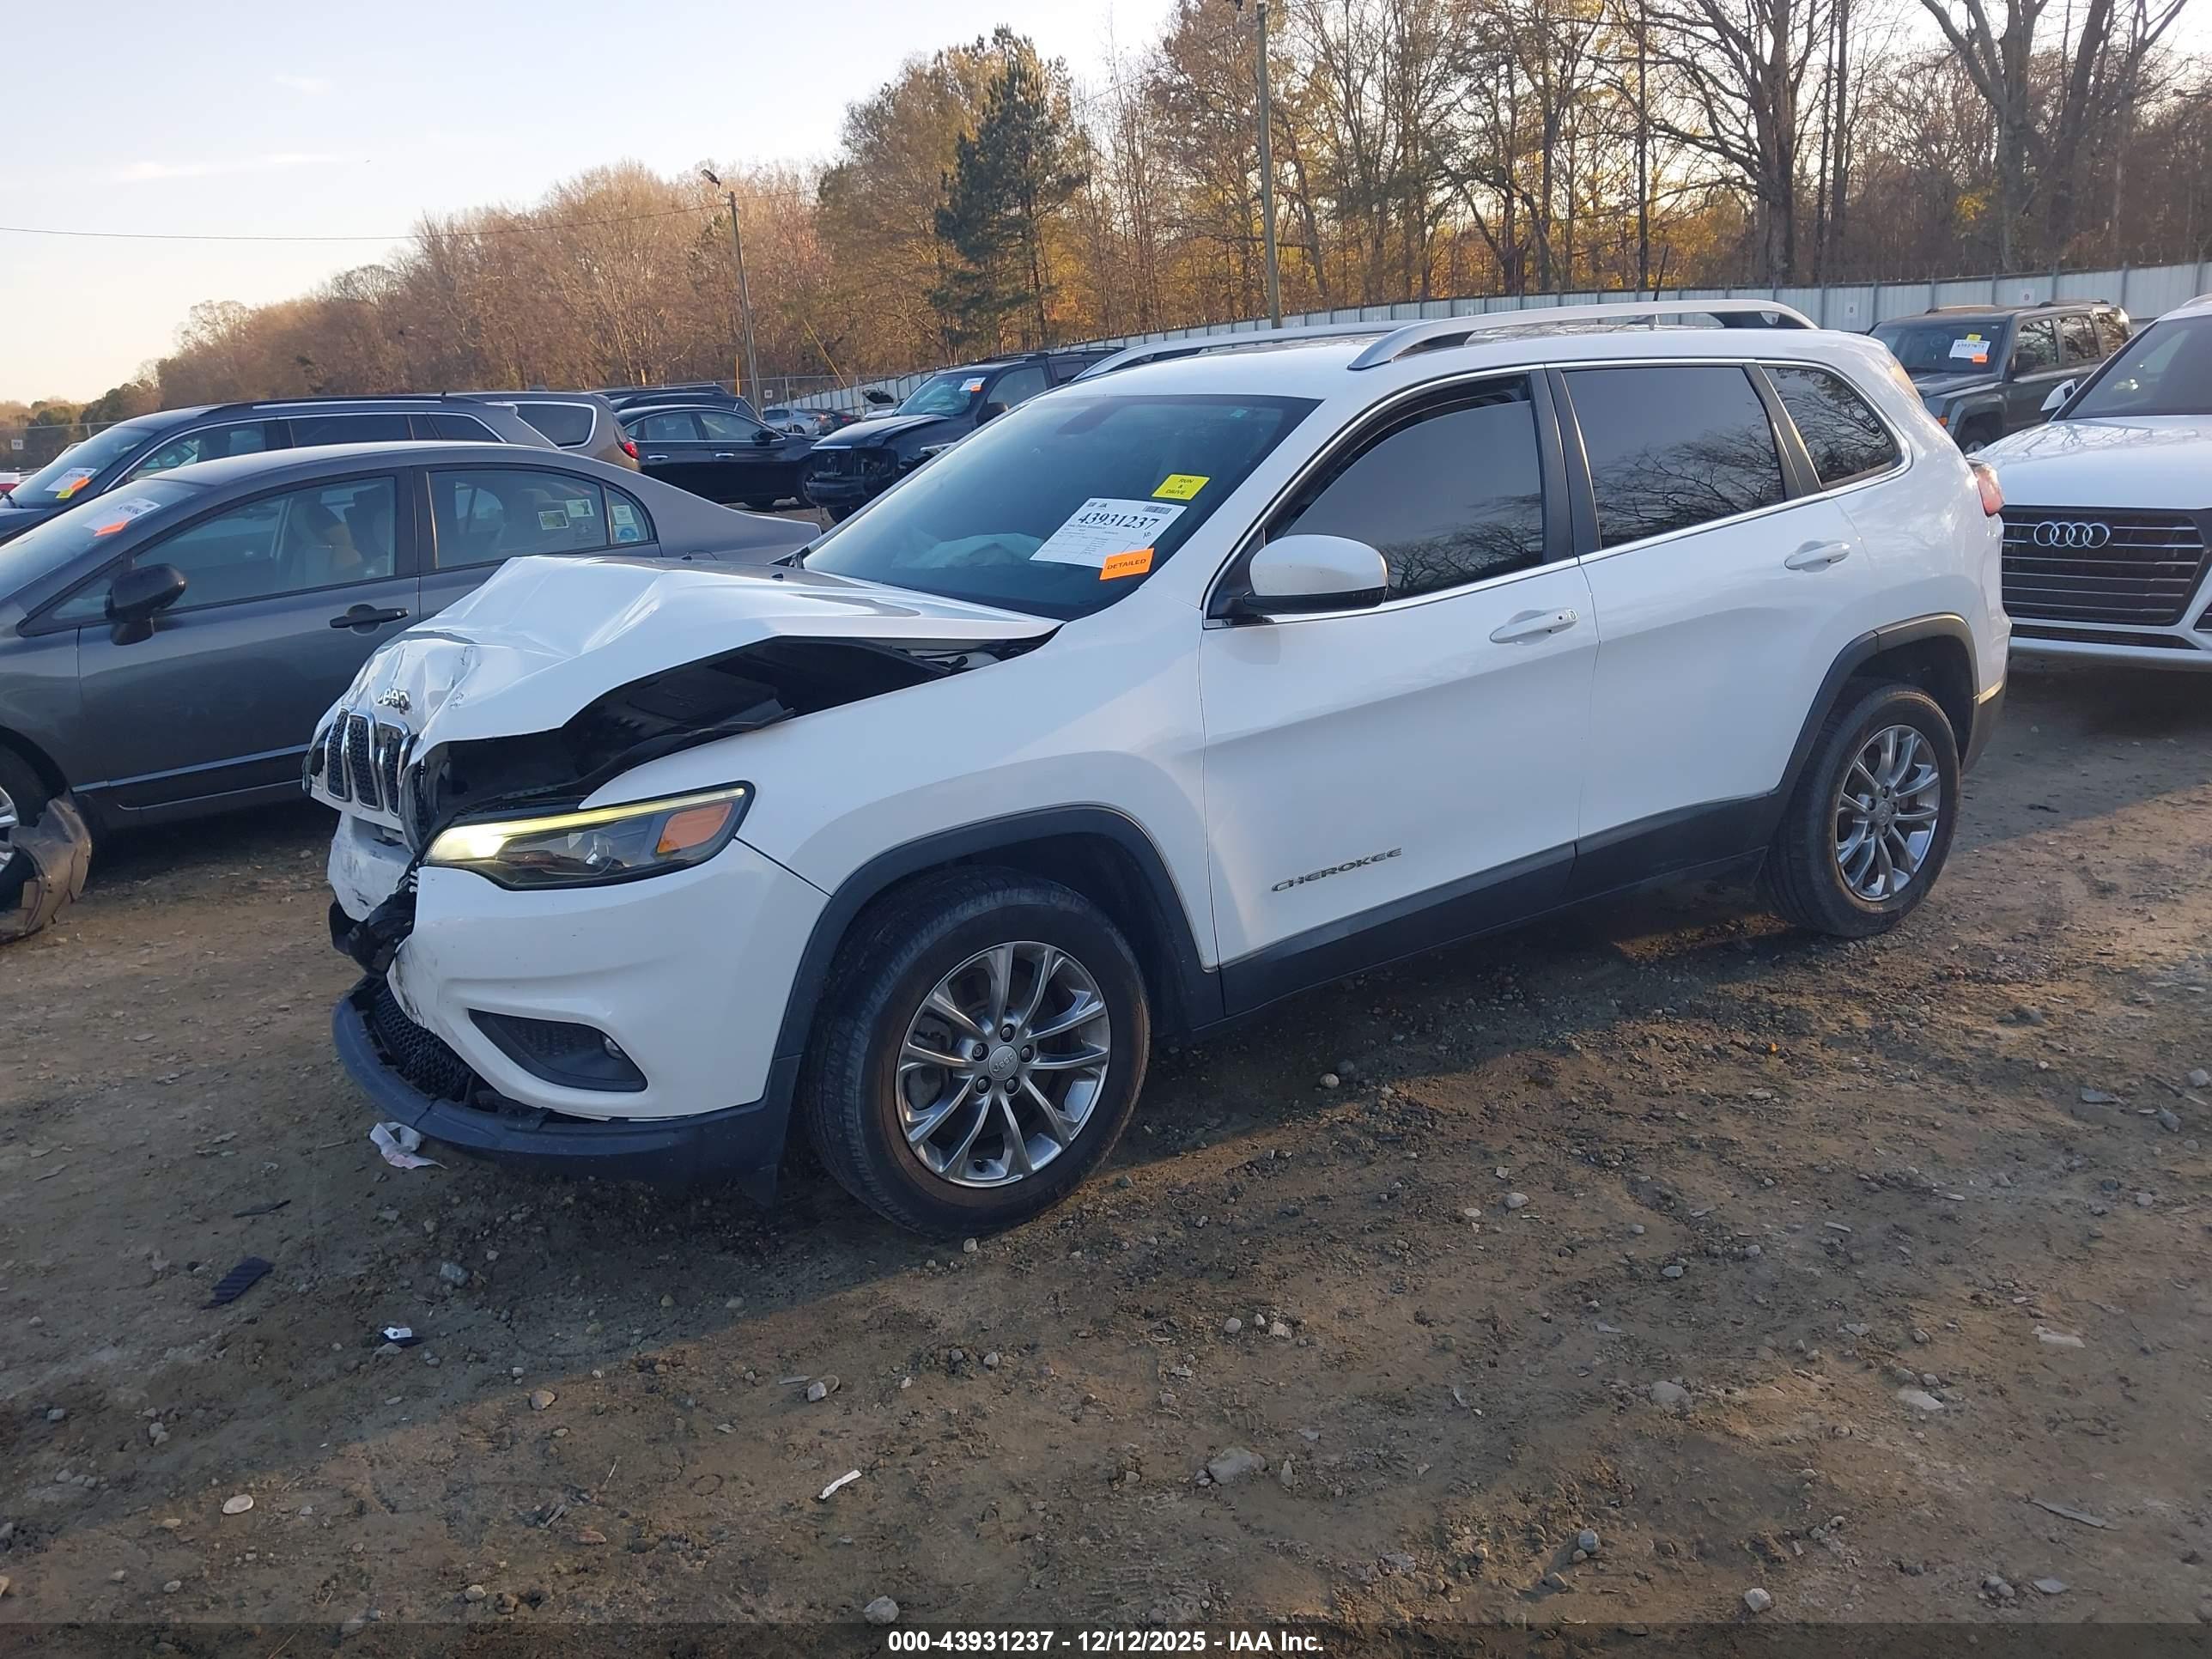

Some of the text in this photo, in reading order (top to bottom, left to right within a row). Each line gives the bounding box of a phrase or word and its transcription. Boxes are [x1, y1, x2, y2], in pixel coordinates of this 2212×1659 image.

[1078, 512, 1161, 531] 43931237
[1107, 558, 1146, 570] DETAILED
[1271, 848, 1402, 892] CHEROKEE
